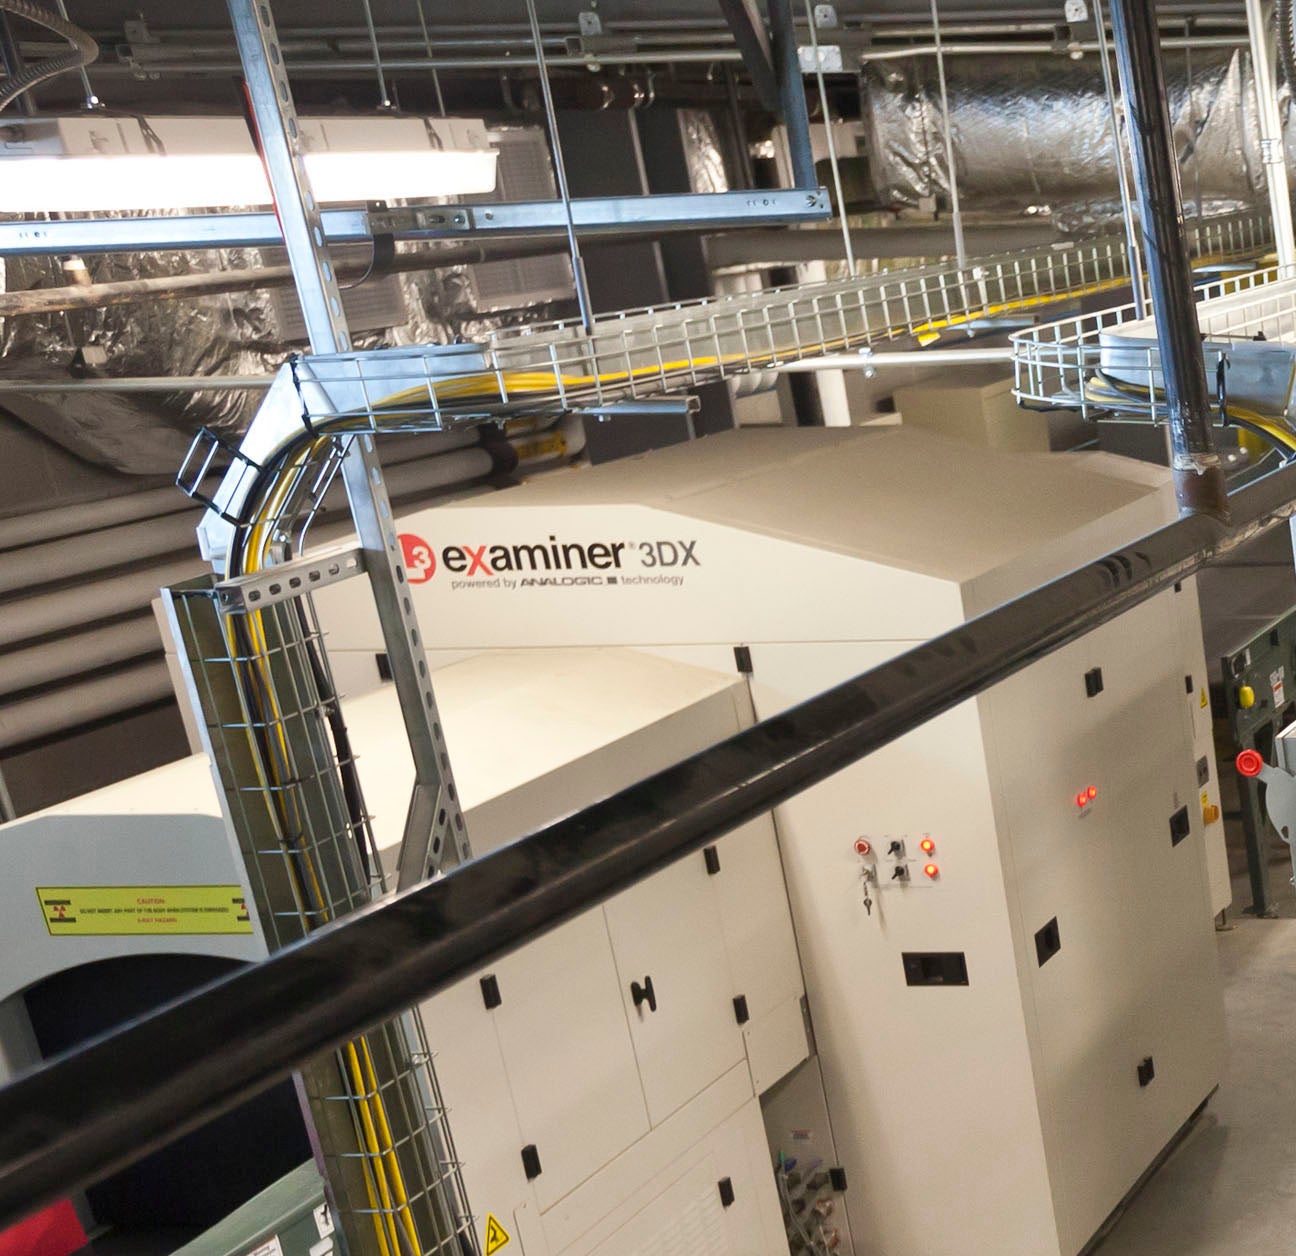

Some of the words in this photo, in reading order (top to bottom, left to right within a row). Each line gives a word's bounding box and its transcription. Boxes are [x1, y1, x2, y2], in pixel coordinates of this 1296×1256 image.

[640, 540, 702, 567] 3DX
[451, 577, 501, 591] powered
[504, 577, 517, 590] by
[520, 575, 603, 588] ANALOGIC
[621, 574, 684, 588] technology
